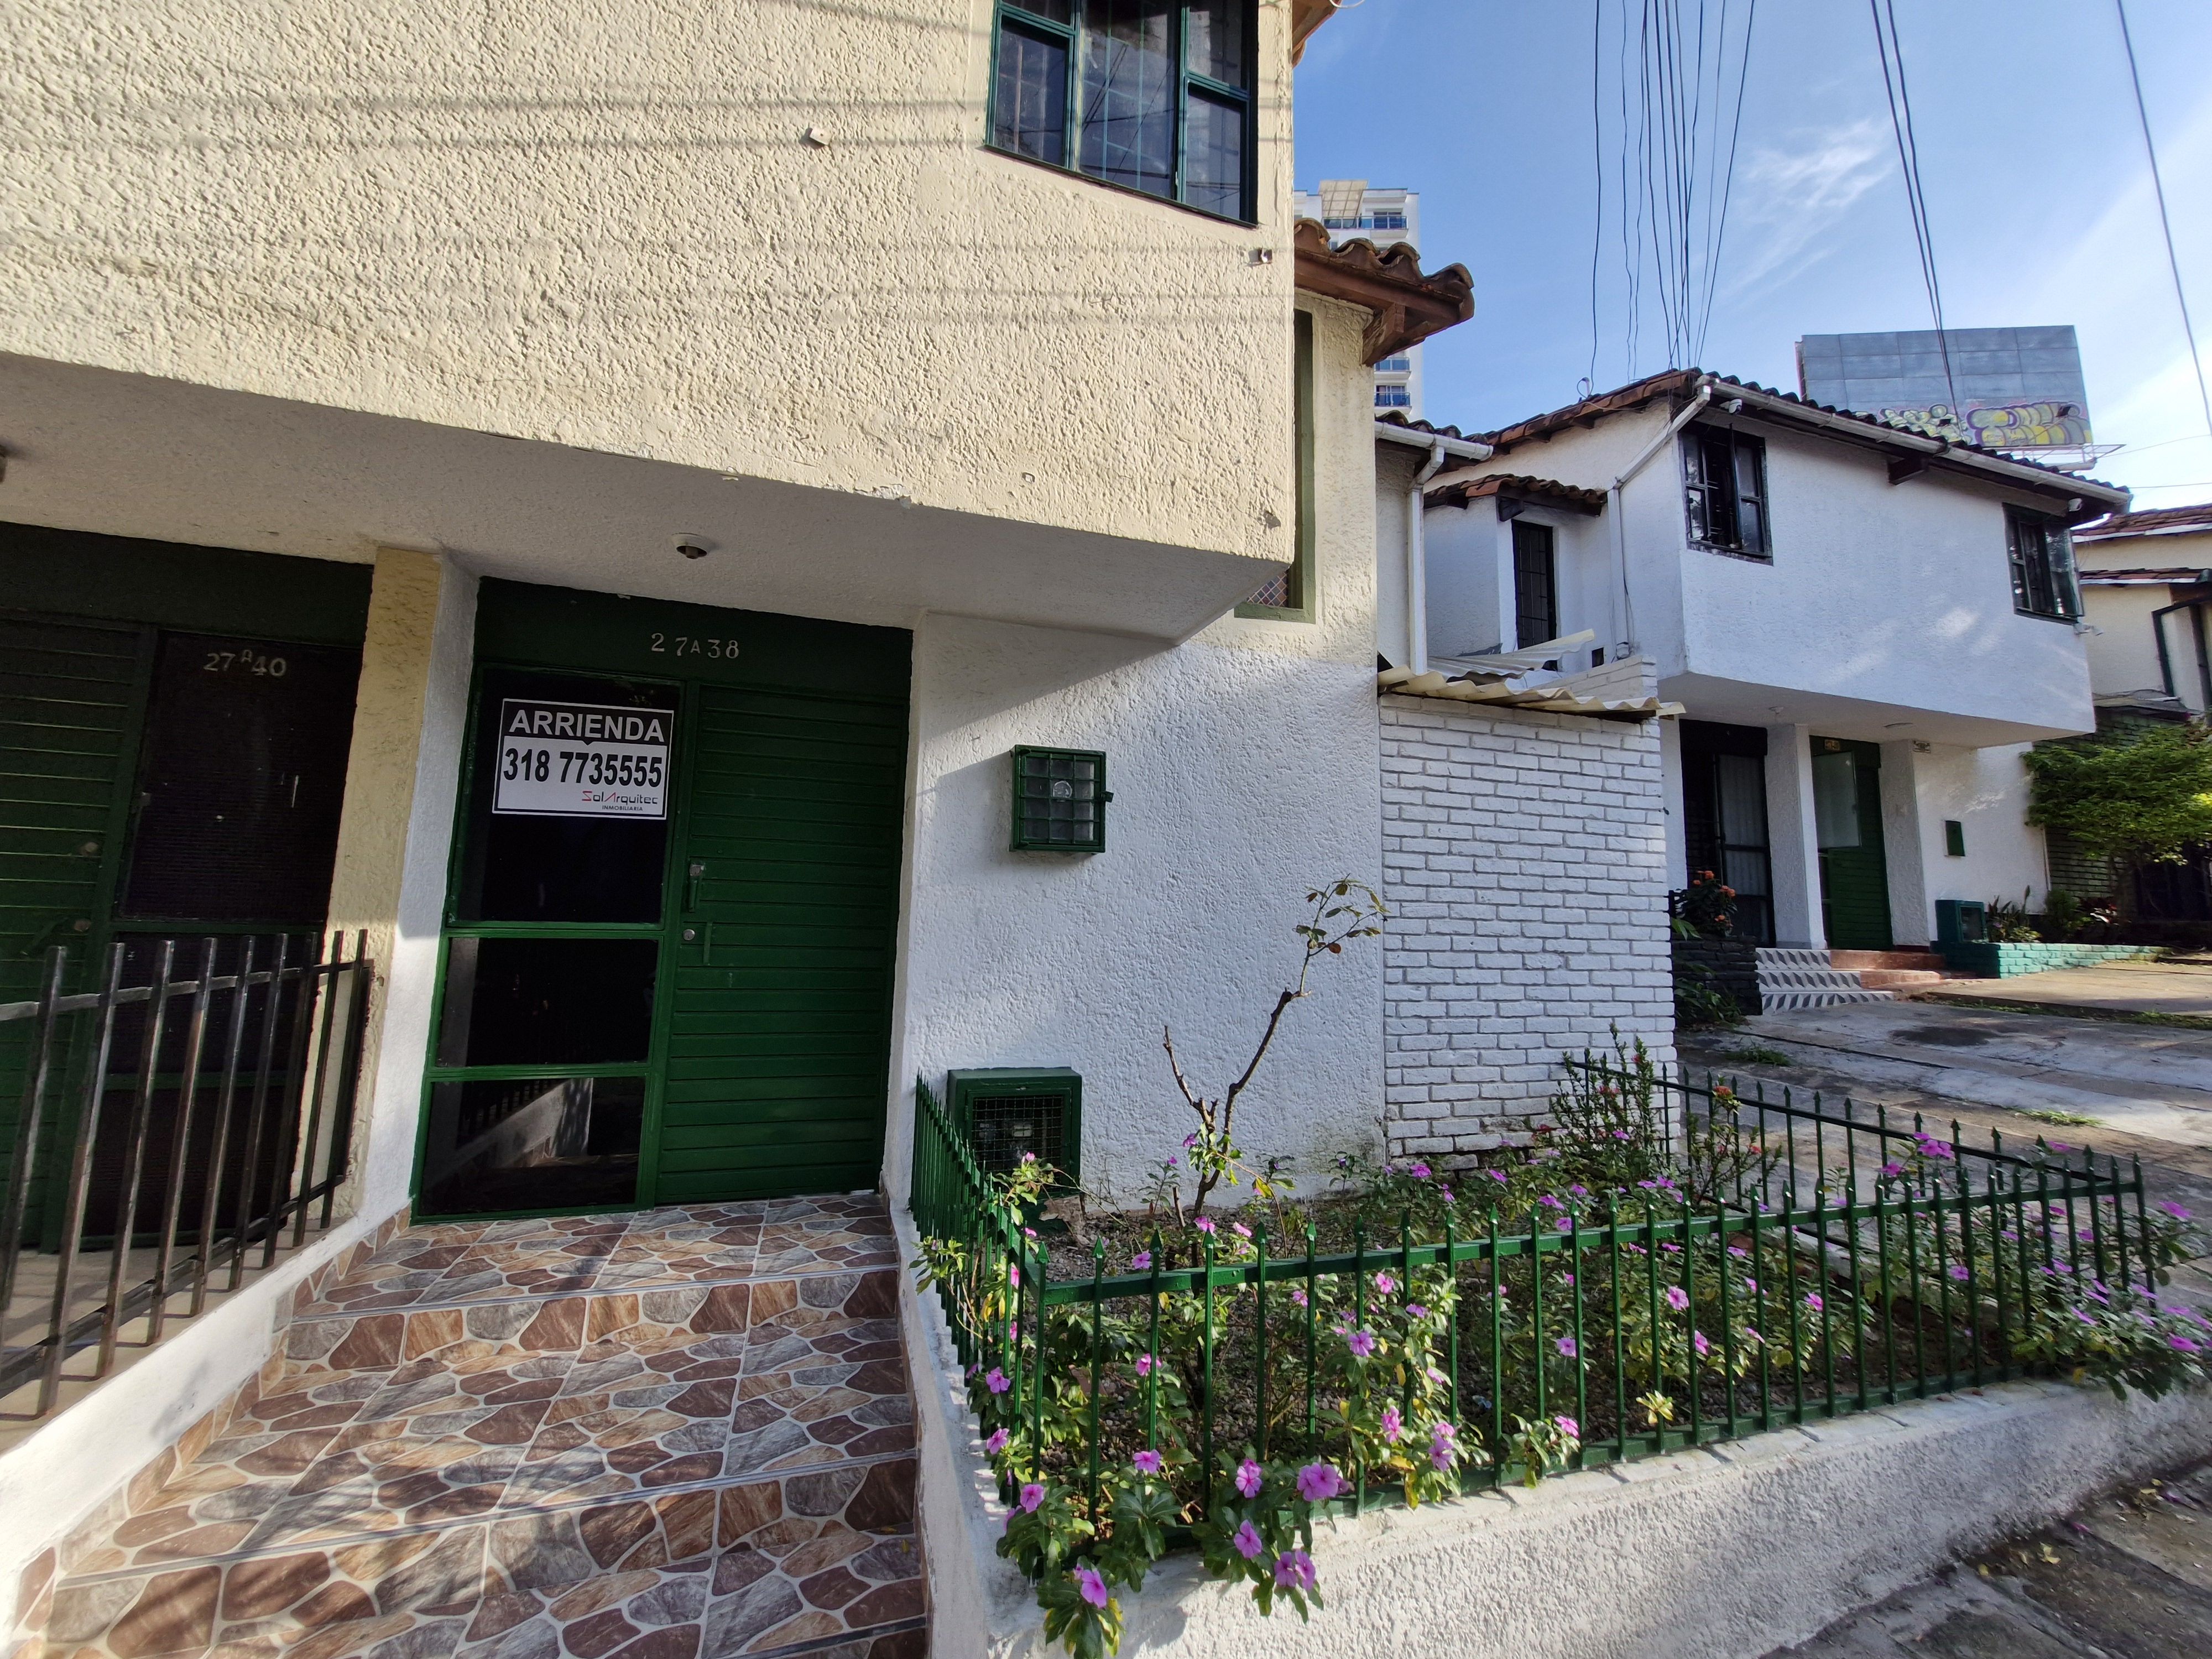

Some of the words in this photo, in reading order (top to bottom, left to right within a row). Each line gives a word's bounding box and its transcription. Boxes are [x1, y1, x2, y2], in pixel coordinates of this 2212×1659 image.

[508, 709, 665, 742] ARRIENDA
[503, 748, 550, 782] 318
[559, 751, 662, 787] 7735555
